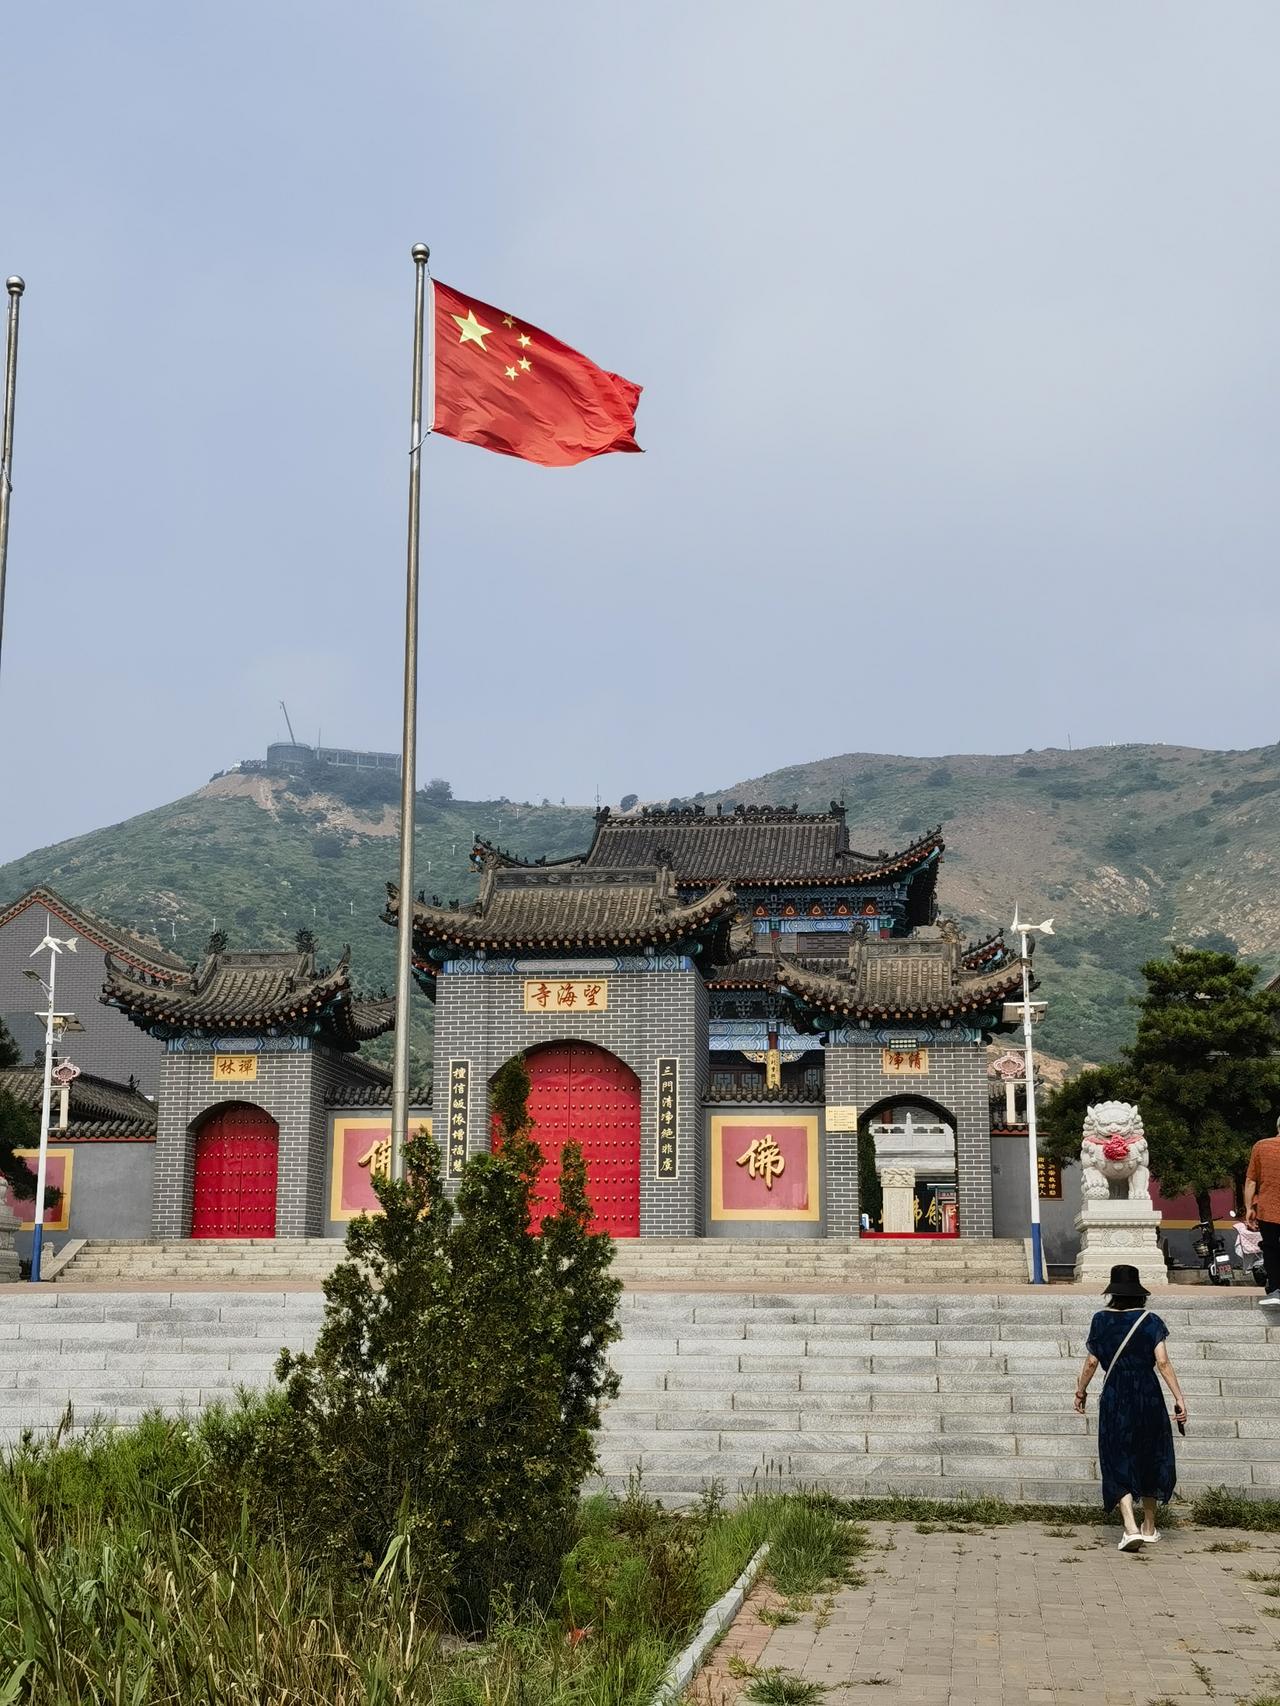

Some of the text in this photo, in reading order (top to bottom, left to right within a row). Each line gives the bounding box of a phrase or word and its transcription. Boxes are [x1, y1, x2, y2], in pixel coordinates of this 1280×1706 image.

[531, 982, 602, 1008] 望海寺
[736, 1133, 786, 1191] 佛
